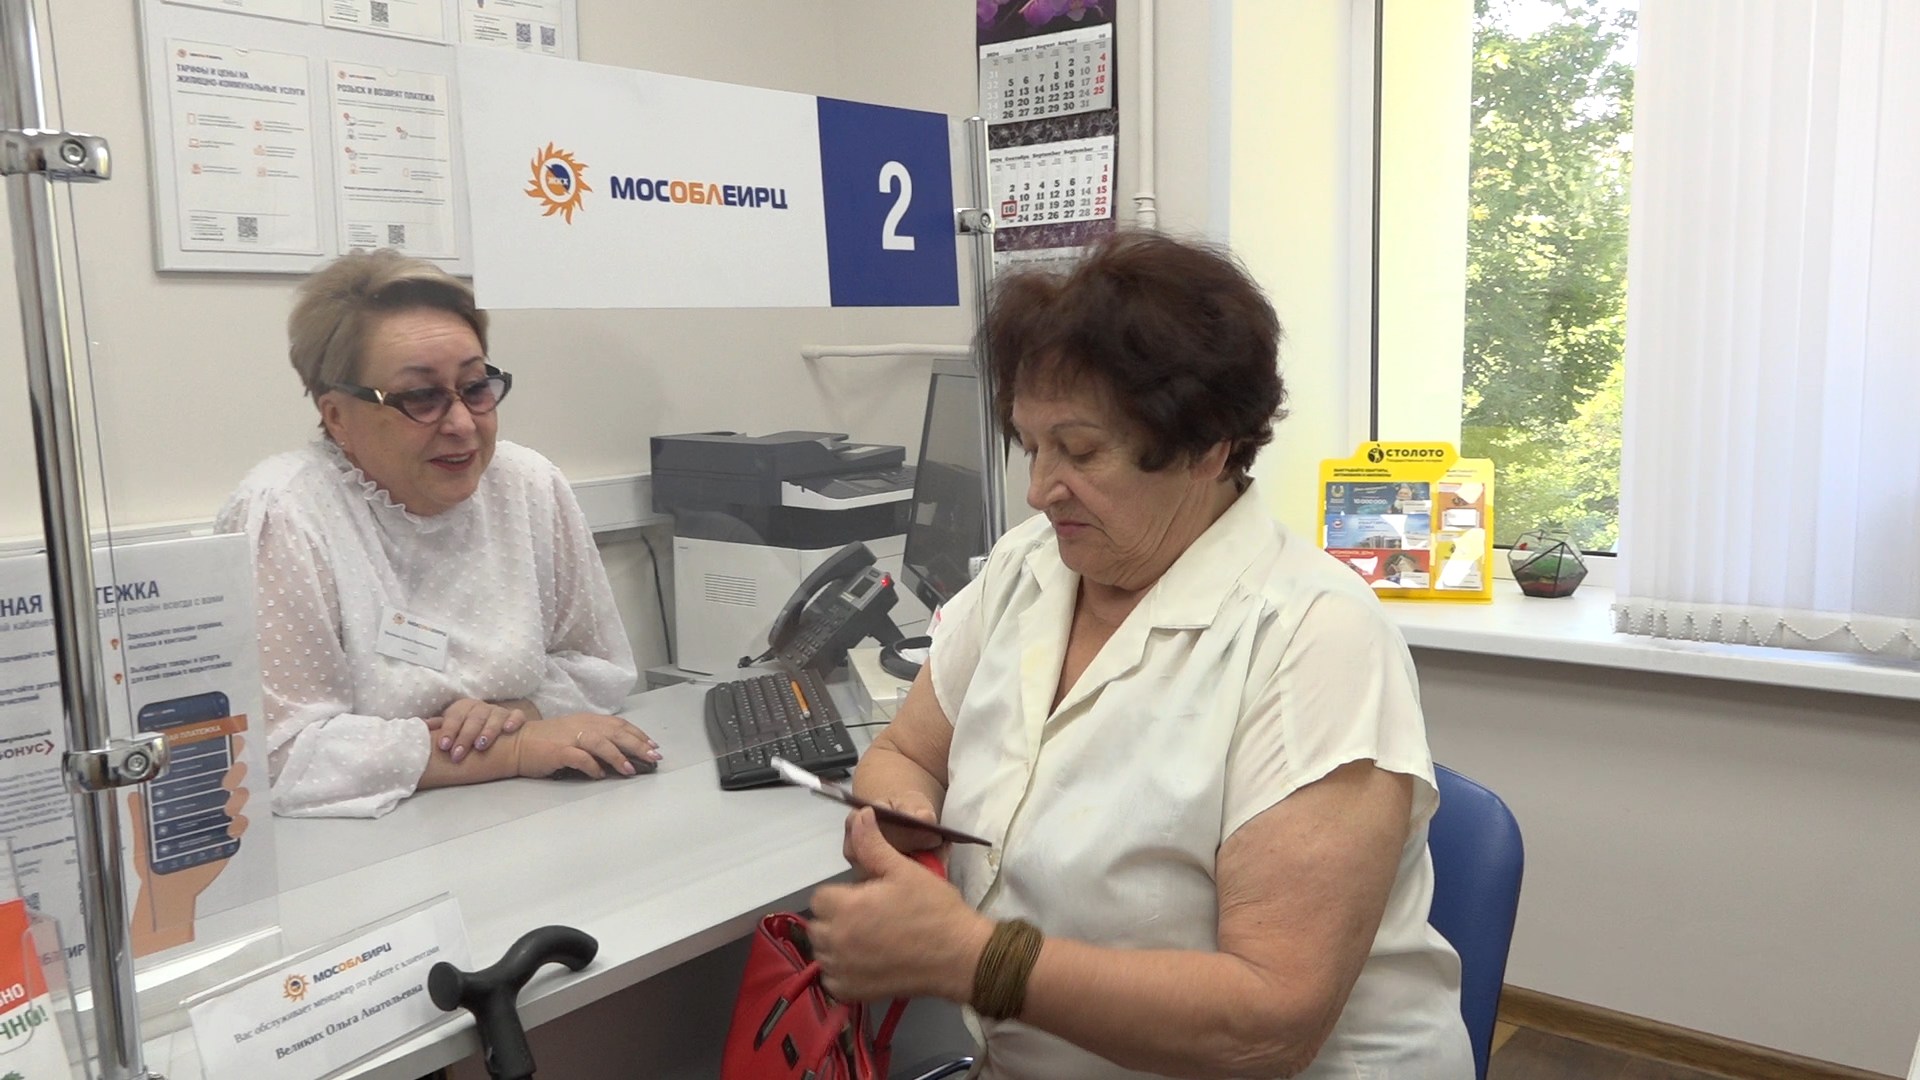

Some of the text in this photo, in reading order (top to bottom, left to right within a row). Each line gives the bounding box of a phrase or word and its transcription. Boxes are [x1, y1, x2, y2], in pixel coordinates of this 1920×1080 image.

[610, 175, 788, 209] МОСОБЛЕИРЦ
[878, 160, 916, 251] 2
[1386, 449, 1444, 457] СТОЛОТО
[313, 942, 393, 983] МОСОБЛЕИРЦ
[234, 1031, 254, 1043] Вас
[254, 1004, 314, 1035] обслуживает
[314, 984, 356, 1009] менеджер
[356, 978, 368, 990] по
[368, 967, 395, 988] работе
[275, 983, 424, 1060] Великих Ольга Анатольевна
